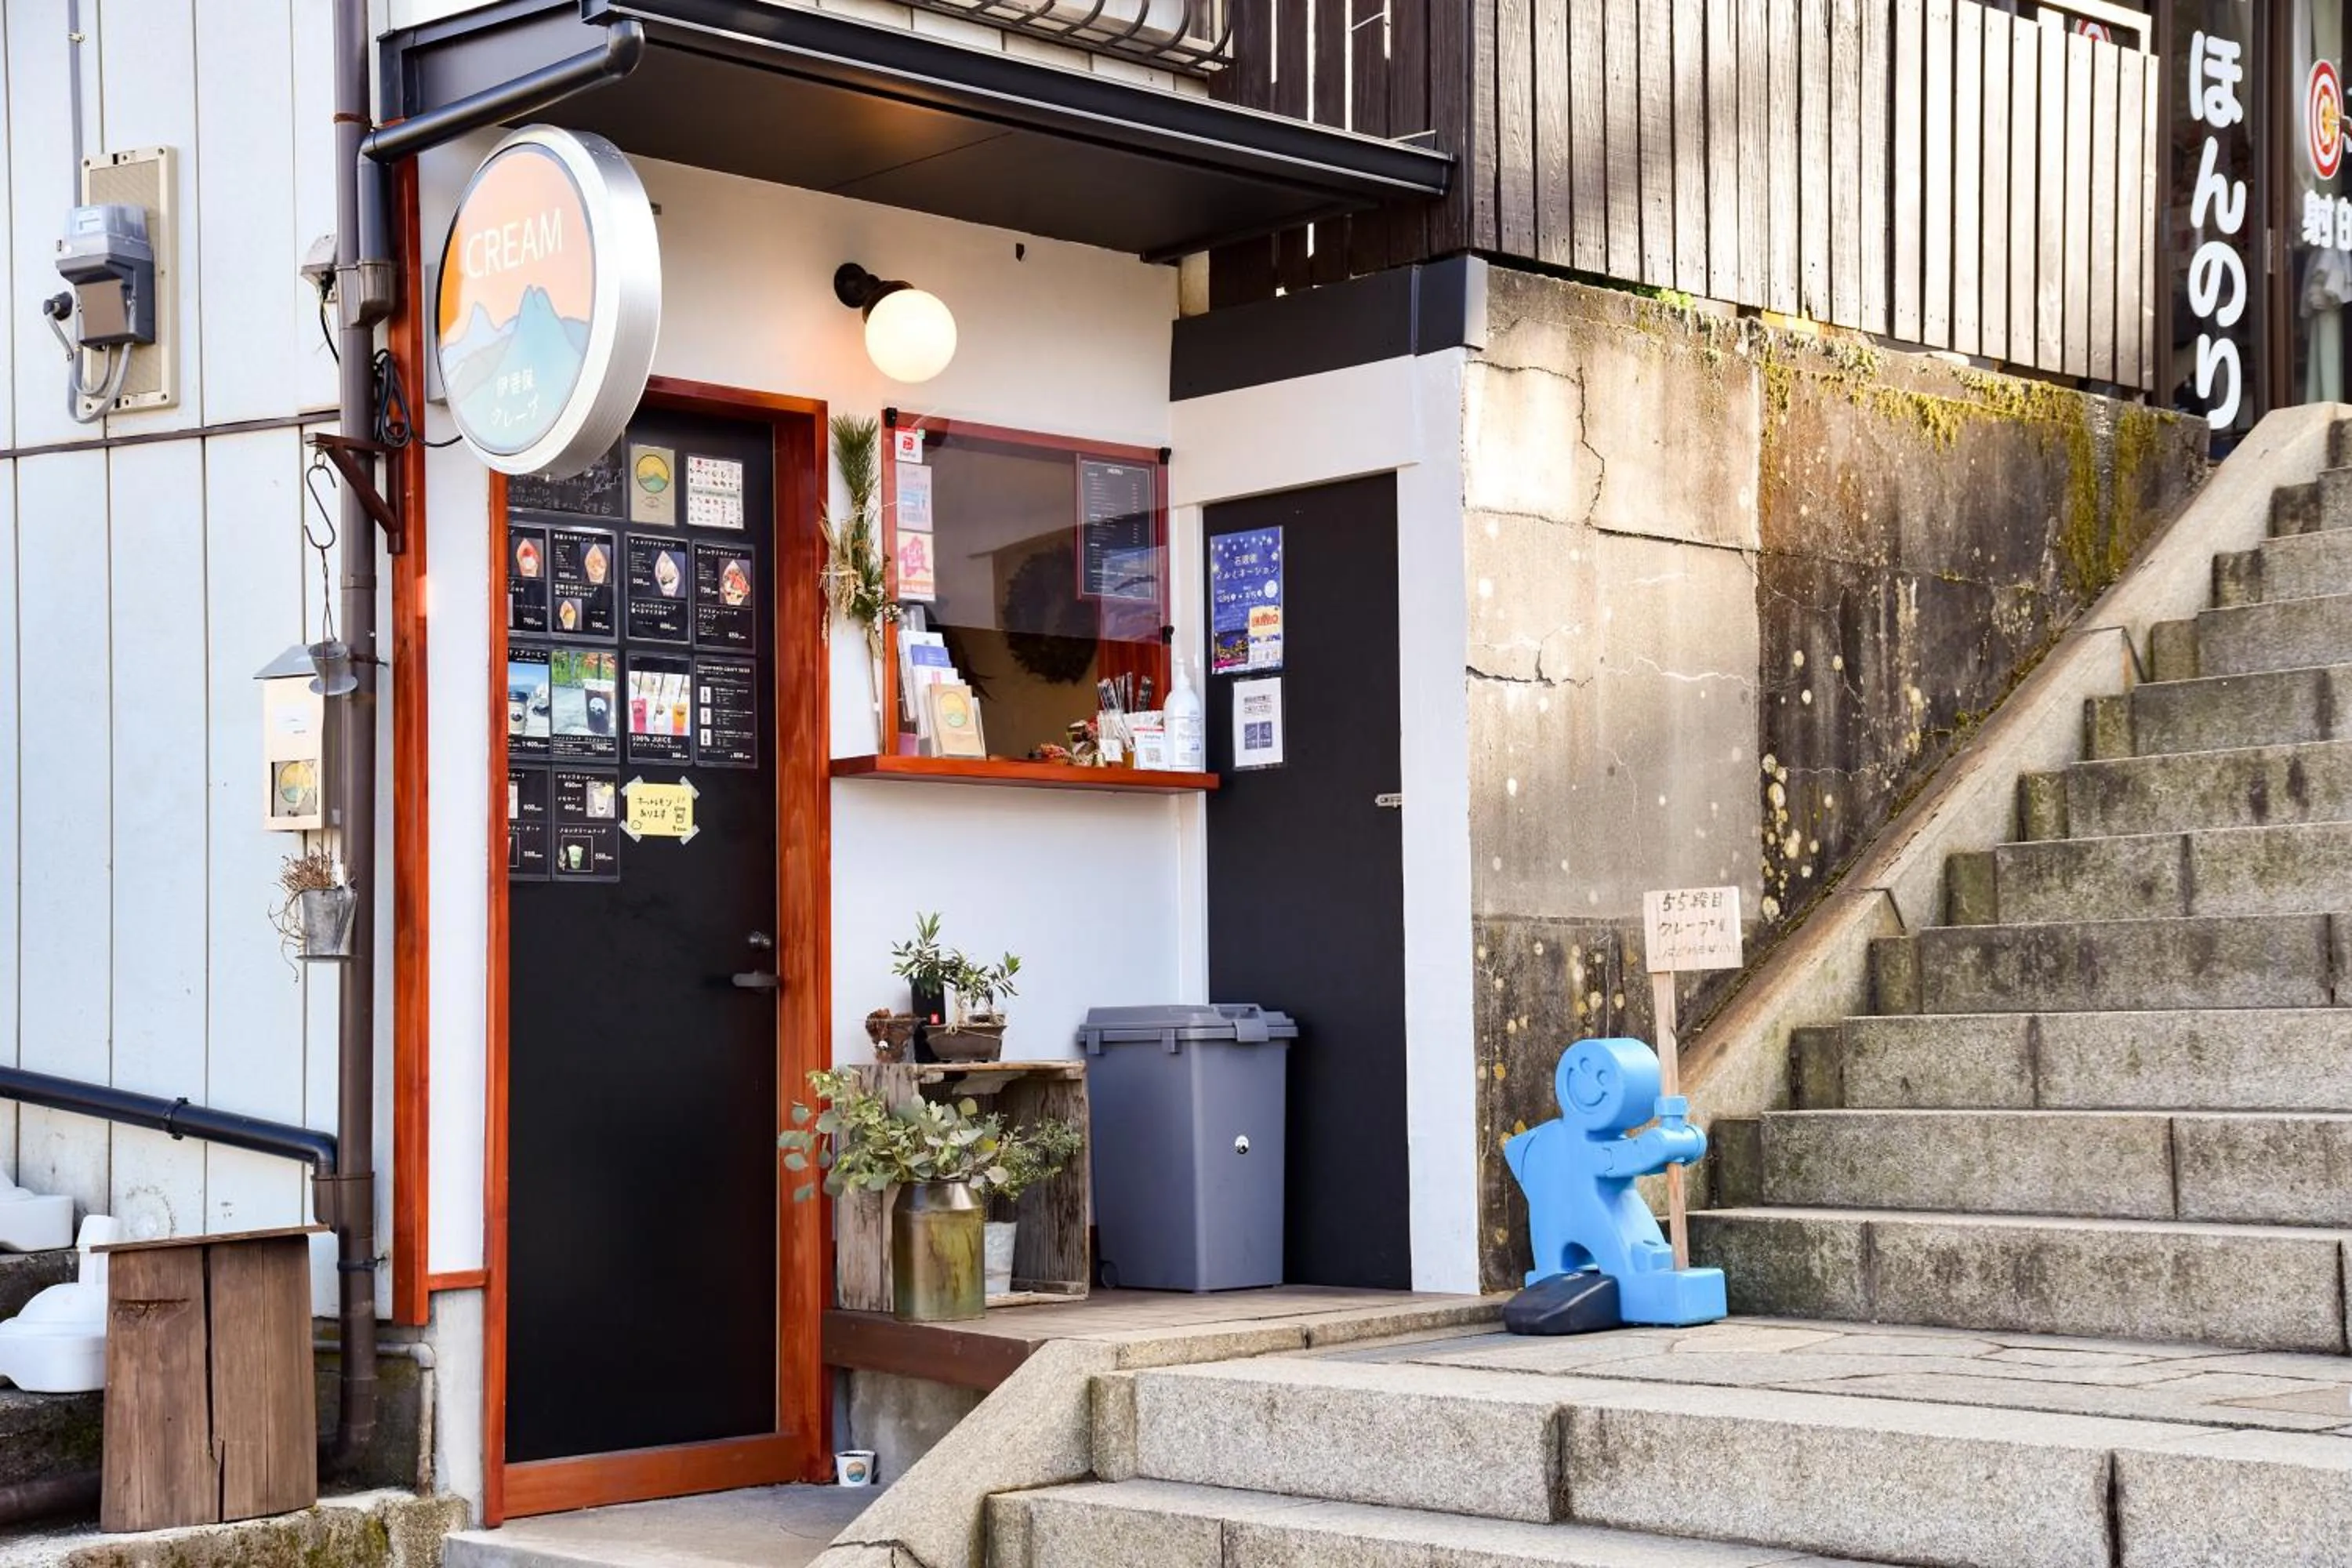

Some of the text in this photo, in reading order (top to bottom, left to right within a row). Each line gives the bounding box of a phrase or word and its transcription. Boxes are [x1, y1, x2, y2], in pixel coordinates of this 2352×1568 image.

[465, 207, 563, 279] CREAM
[2188, 31, 2247, 430] ほんのり
[490, 392, 539, 427] クレープ
[640, 808, 666, 819] あります
